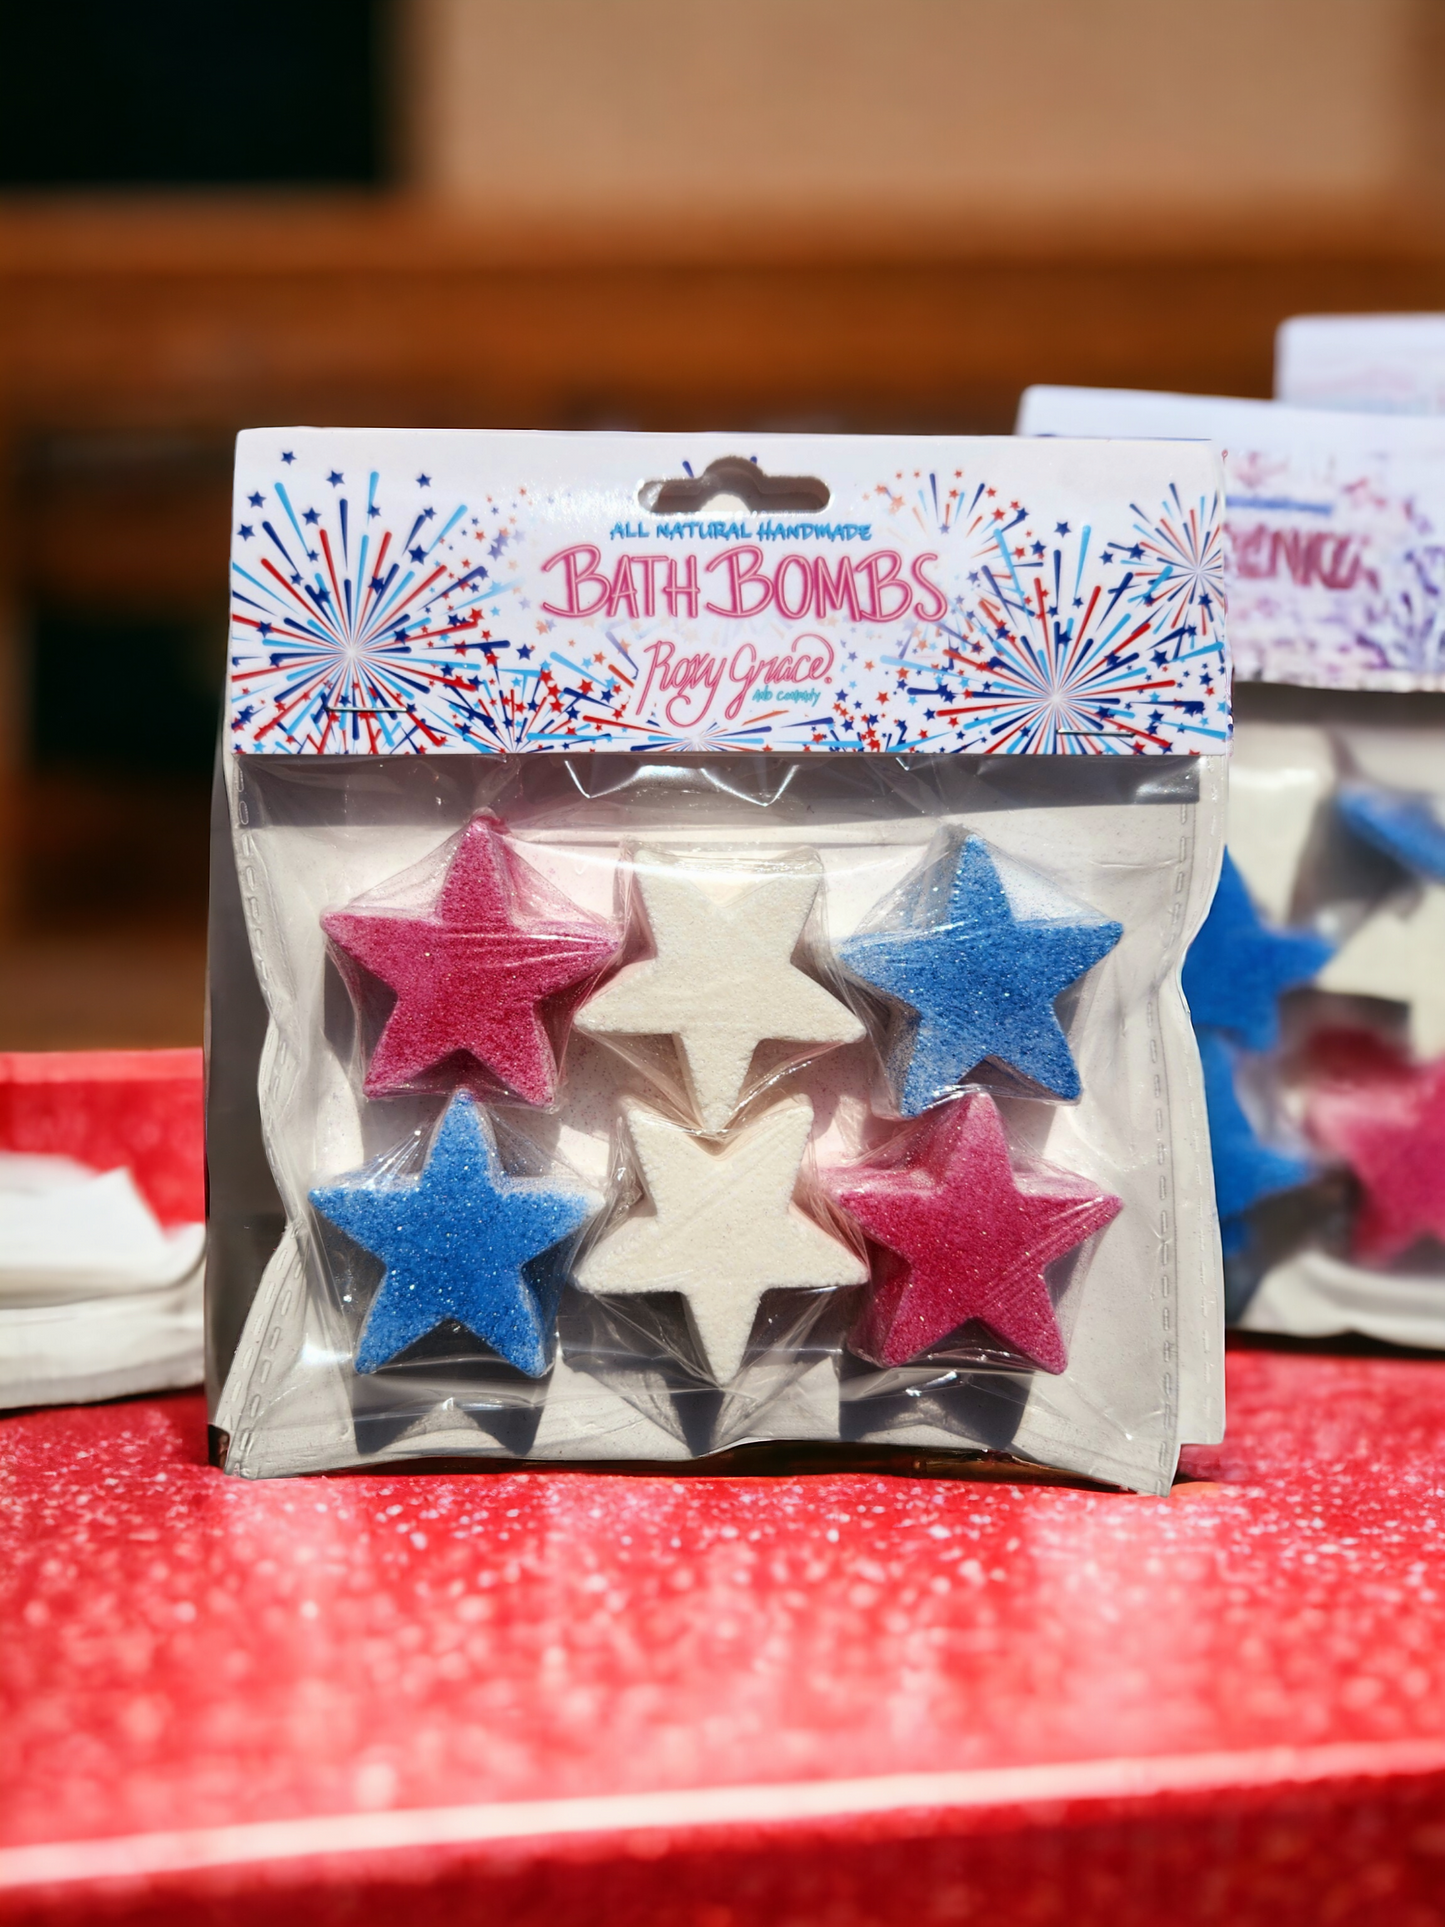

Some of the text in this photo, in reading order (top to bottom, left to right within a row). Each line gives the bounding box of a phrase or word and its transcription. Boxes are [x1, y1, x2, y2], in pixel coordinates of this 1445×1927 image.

[610, 519, 873, 542] ALL NATURAL HANDMADE
[541, 544, 949, 624] BATH BOMBS
[635, 640, 727, 728] Roxy
